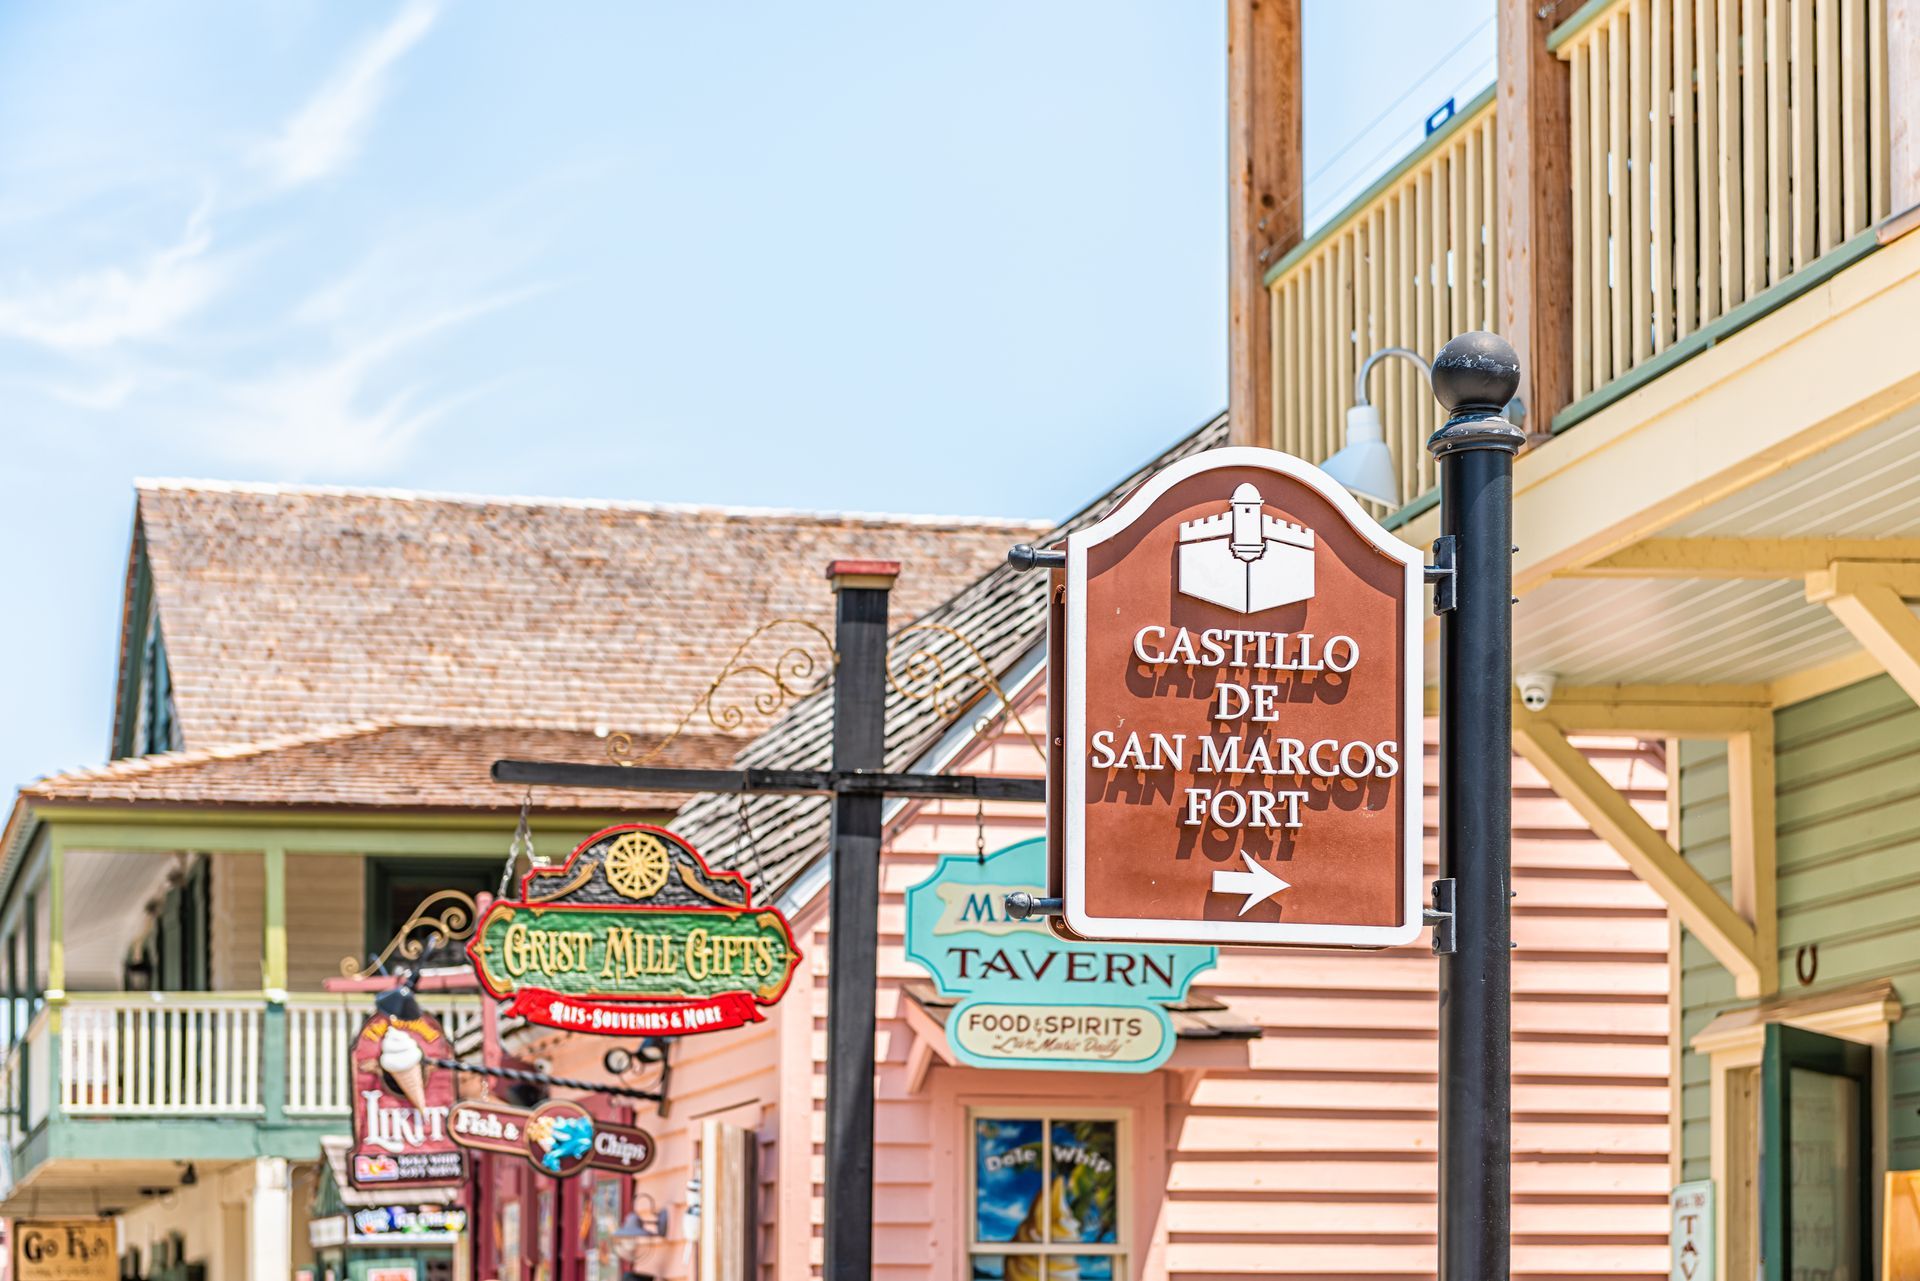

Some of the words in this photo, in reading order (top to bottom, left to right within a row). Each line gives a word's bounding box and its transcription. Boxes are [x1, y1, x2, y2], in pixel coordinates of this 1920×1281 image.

[1133, 625, 1360, 673] CASTILLO
[1214, 682, 1279, 722] DE
[1091, 730, 1187, 771] SAN
[1197, 735, 1399, 779] MARCOS
[1184, 787, 1309, 828] FORT
[504, 923, 593, 977] GRIST
[600, 926, 679, 985] MILL
[684, 927, 774, 981] GIFTS
[946, 947, 1176, 988] TAVERN
[968, 1014, 1030, 1033] FOOD
[1044, 1015, 1142, 1036] SPIRITS
[455, 1108, 502, 1138] Fish
[503, 1122, 519, 1141] &
[594, 1132, 646, 1165] Chips
[986, 1148, 1037, 1172] Dole
[1053, 1146, 1112, 1173] Whip
